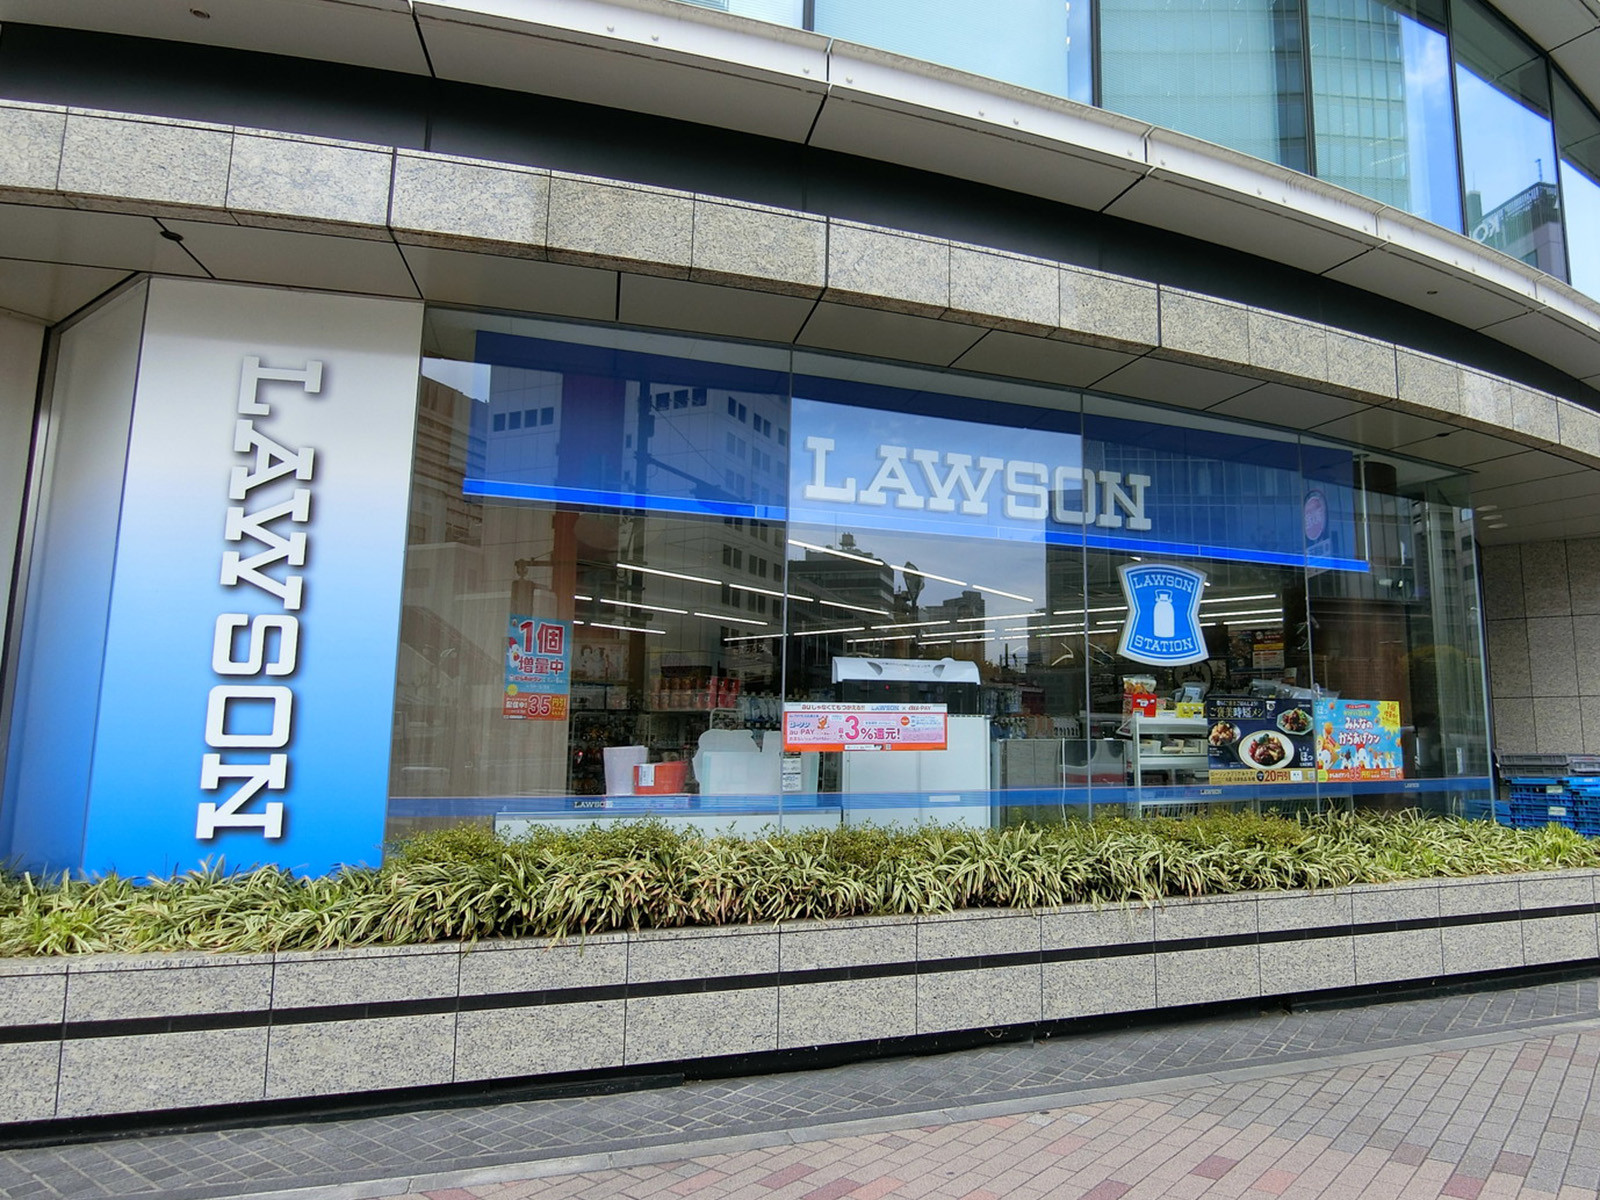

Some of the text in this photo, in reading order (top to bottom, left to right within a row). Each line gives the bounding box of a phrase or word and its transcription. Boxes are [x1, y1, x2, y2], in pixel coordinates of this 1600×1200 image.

[804, 436, 1152, 531] LAWSON
[1133, 574, 1194, 594] LAWSON
[196, 355, 323, 839] LAWSON
[519, 620, 565, 655] 1個
[1134, 635, 1194, 653] STATION
[518, 656, 565, 675] 増量中
[800, 728, 815, 736] PAY
[1344, 716, 1374, 729] みんなの
[1338, 729, 1380, 746] からあげクン
